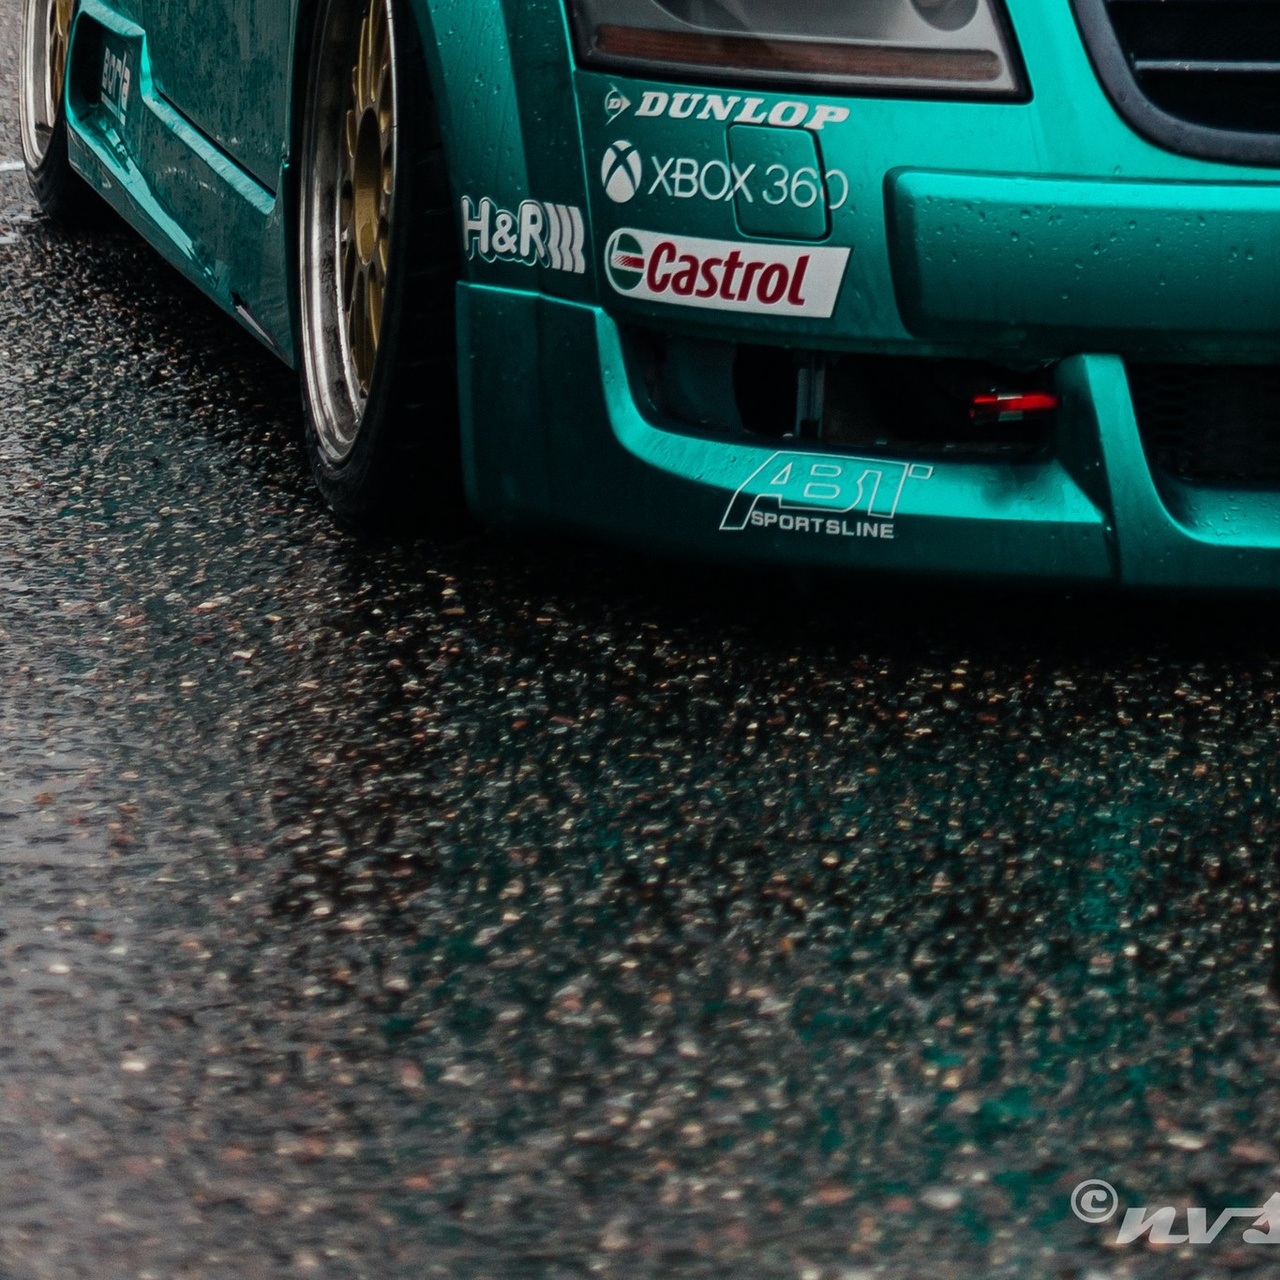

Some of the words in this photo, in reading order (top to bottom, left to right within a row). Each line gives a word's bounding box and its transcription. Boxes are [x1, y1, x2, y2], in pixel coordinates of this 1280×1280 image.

[635, 91, 851, 131] DUNLOP
[647, 155, 755, 204] XBOX
[763, 163, 851, 211] 360
[461, 195, 551, 265] H&R
[646, 241, 811, 307] Castrol
[719, 450, 934, 531] ABT
[751, 509, 895, 540] SPORTSLINE
